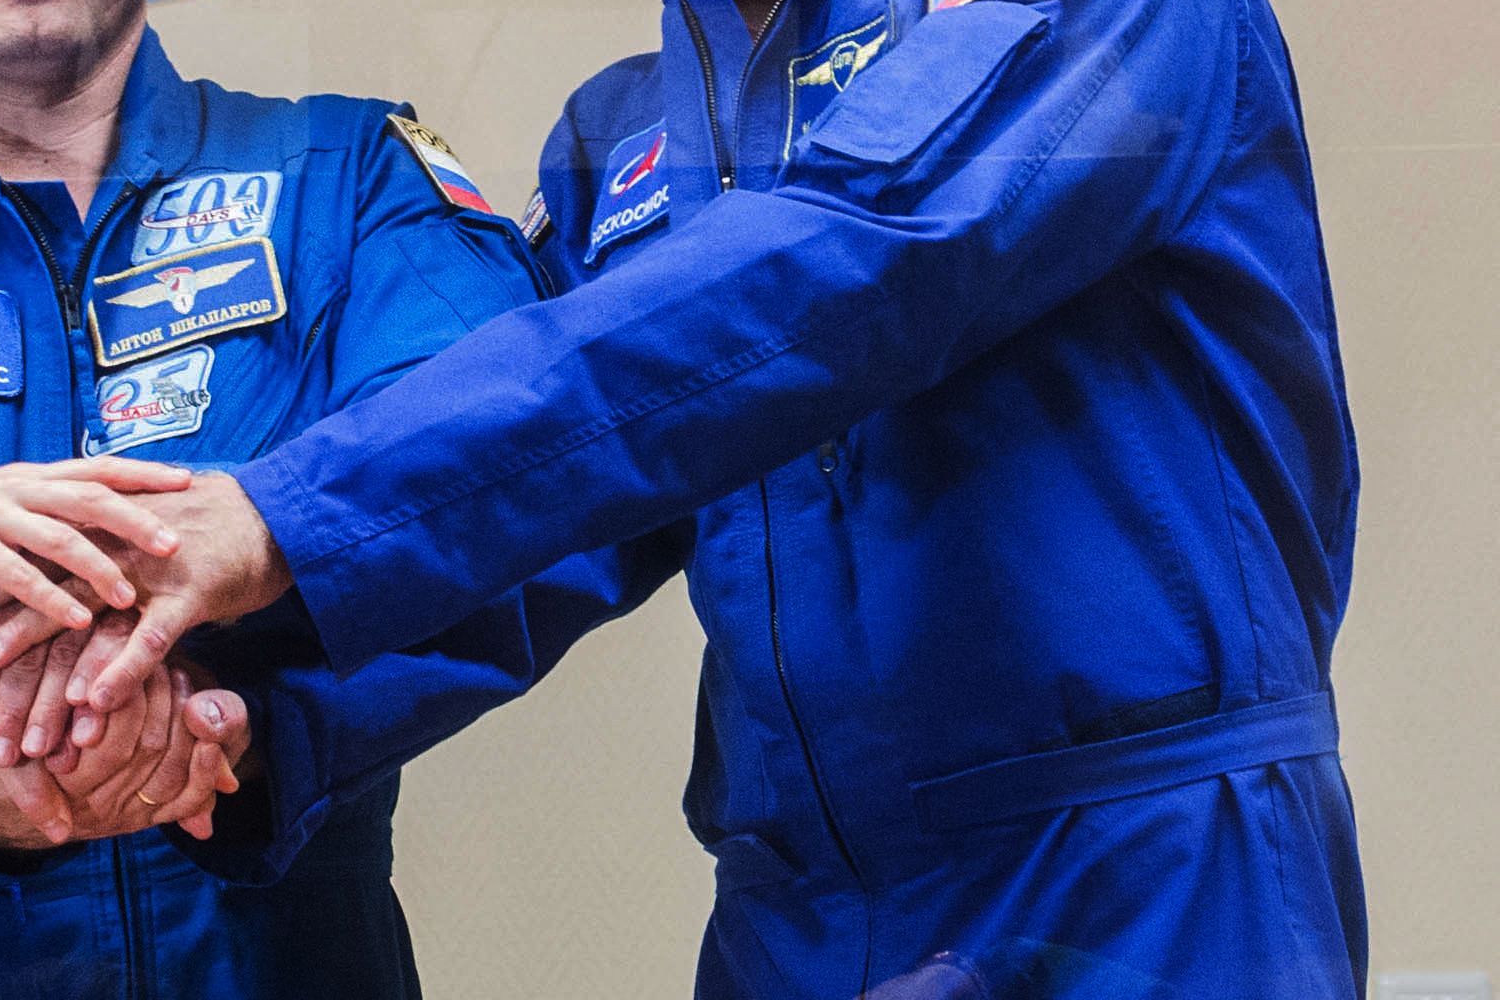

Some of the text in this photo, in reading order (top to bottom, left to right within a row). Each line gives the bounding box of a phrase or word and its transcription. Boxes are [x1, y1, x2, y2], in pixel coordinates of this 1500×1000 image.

[145, 175, 268, 256] 500
[109, 299, 272, 356] АНТОН ШКАПЛЕРОВ
